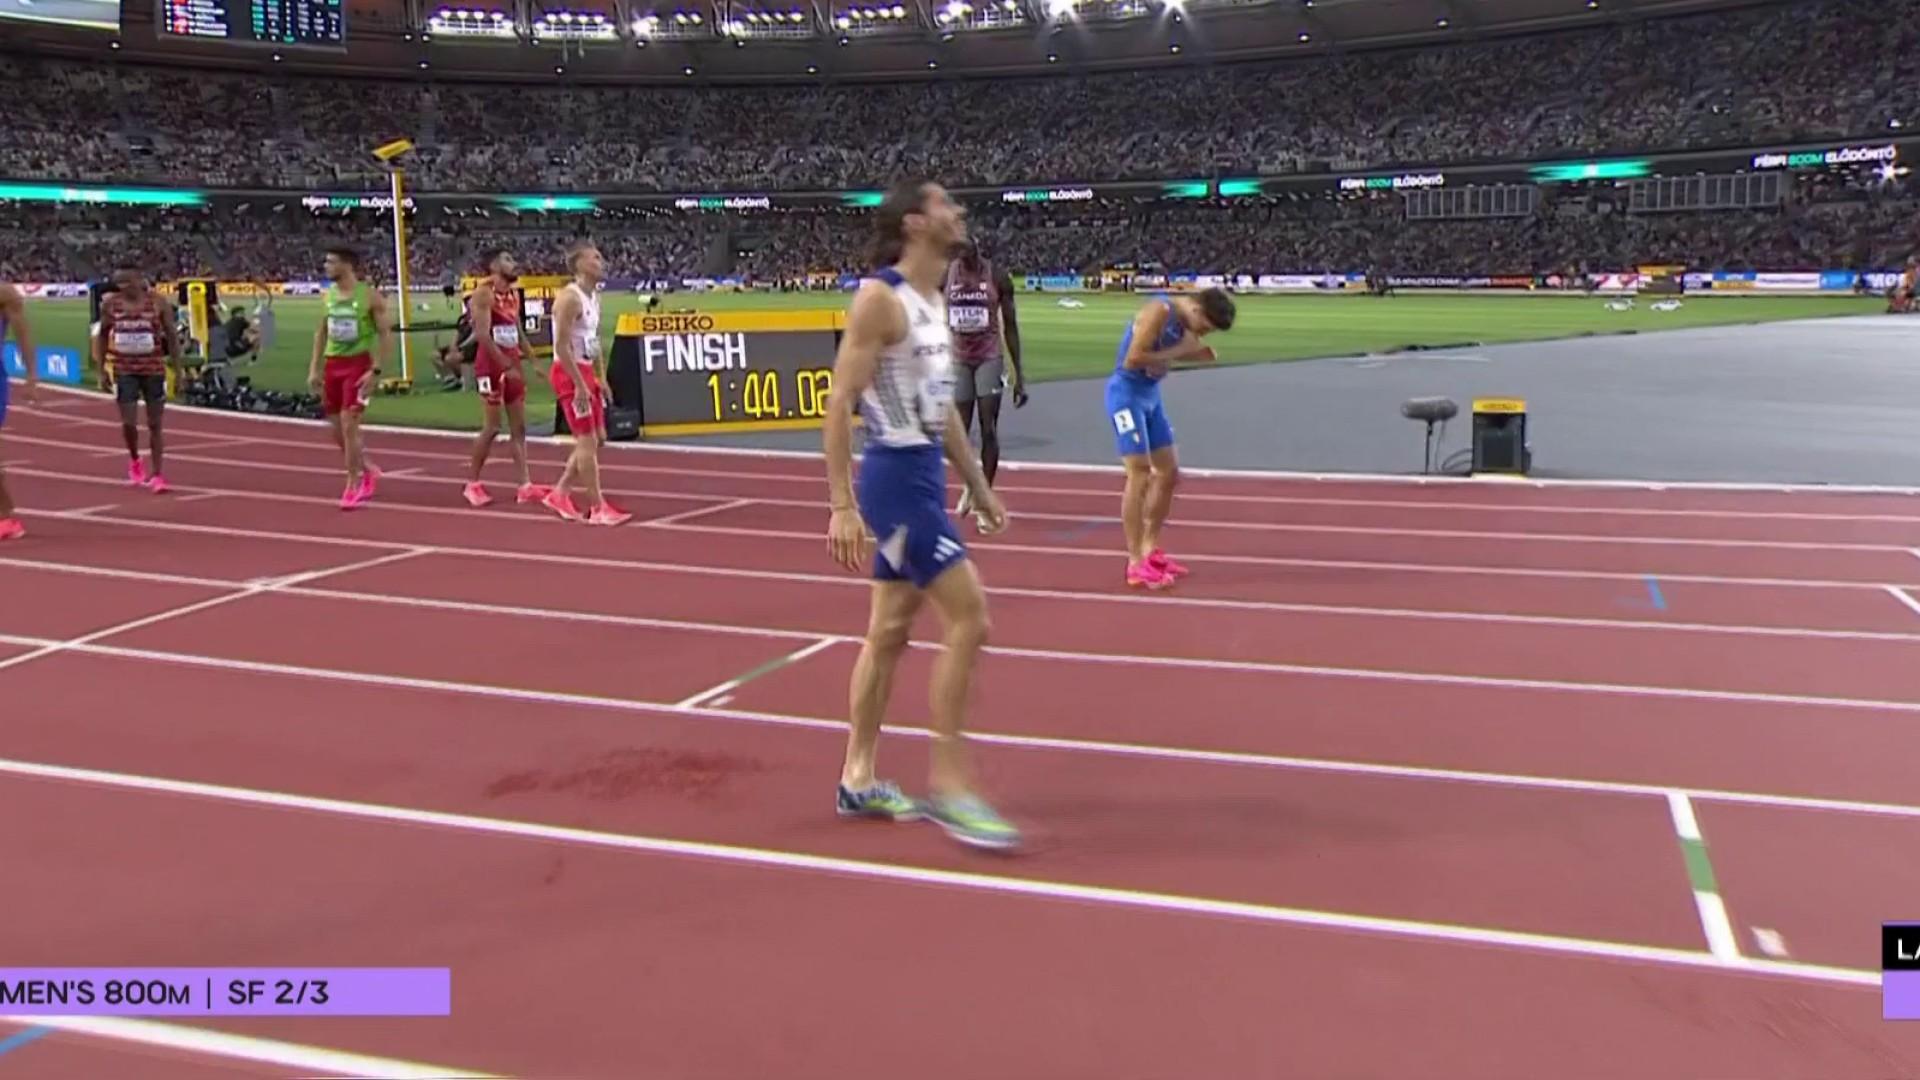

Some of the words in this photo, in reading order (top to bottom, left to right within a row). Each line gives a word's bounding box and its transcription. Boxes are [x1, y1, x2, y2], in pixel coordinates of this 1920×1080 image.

[949, 291, 989, 301] CANADA
[642, 315, 714, 333] SEIKO
[643, 332, 747, 373] FINISH
[707, 369, 832, 421] 1:44.02
